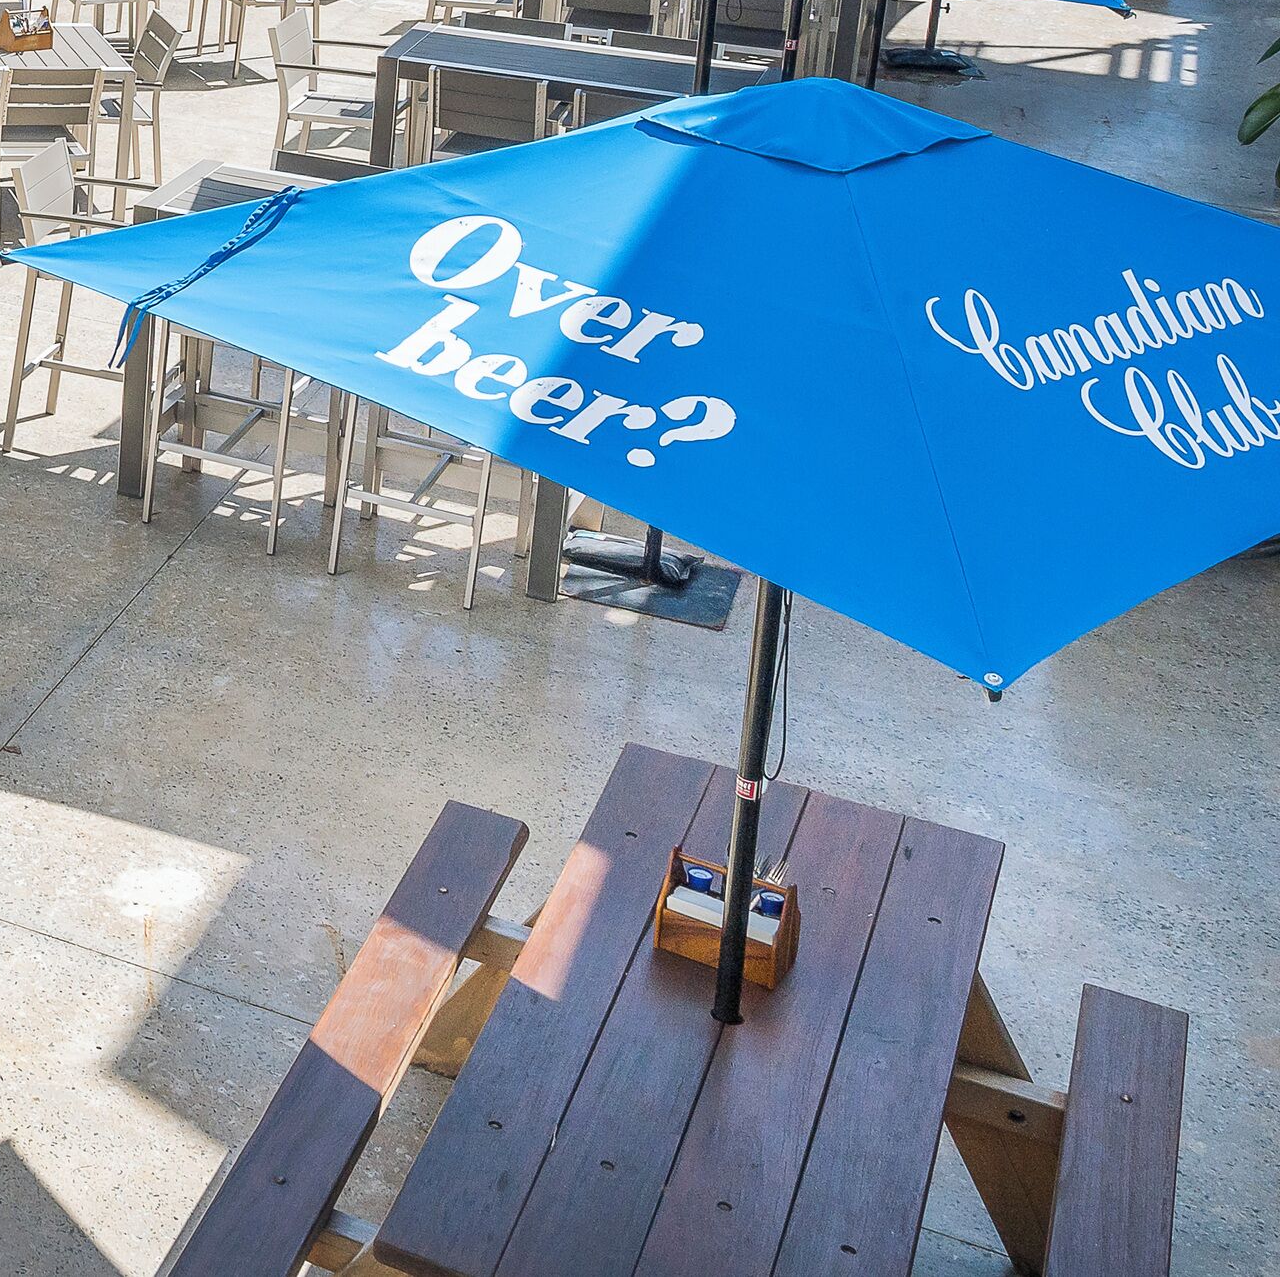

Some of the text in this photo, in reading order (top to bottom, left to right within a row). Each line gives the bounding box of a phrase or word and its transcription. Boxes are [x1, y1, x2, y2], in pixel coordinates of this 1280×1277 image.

[410, 214, 705, 364] Over
[925, 268, 1265, 391] Canadian
[374, 294, 737, 467] beer?
[1080, 353, 1280, 469] Club
